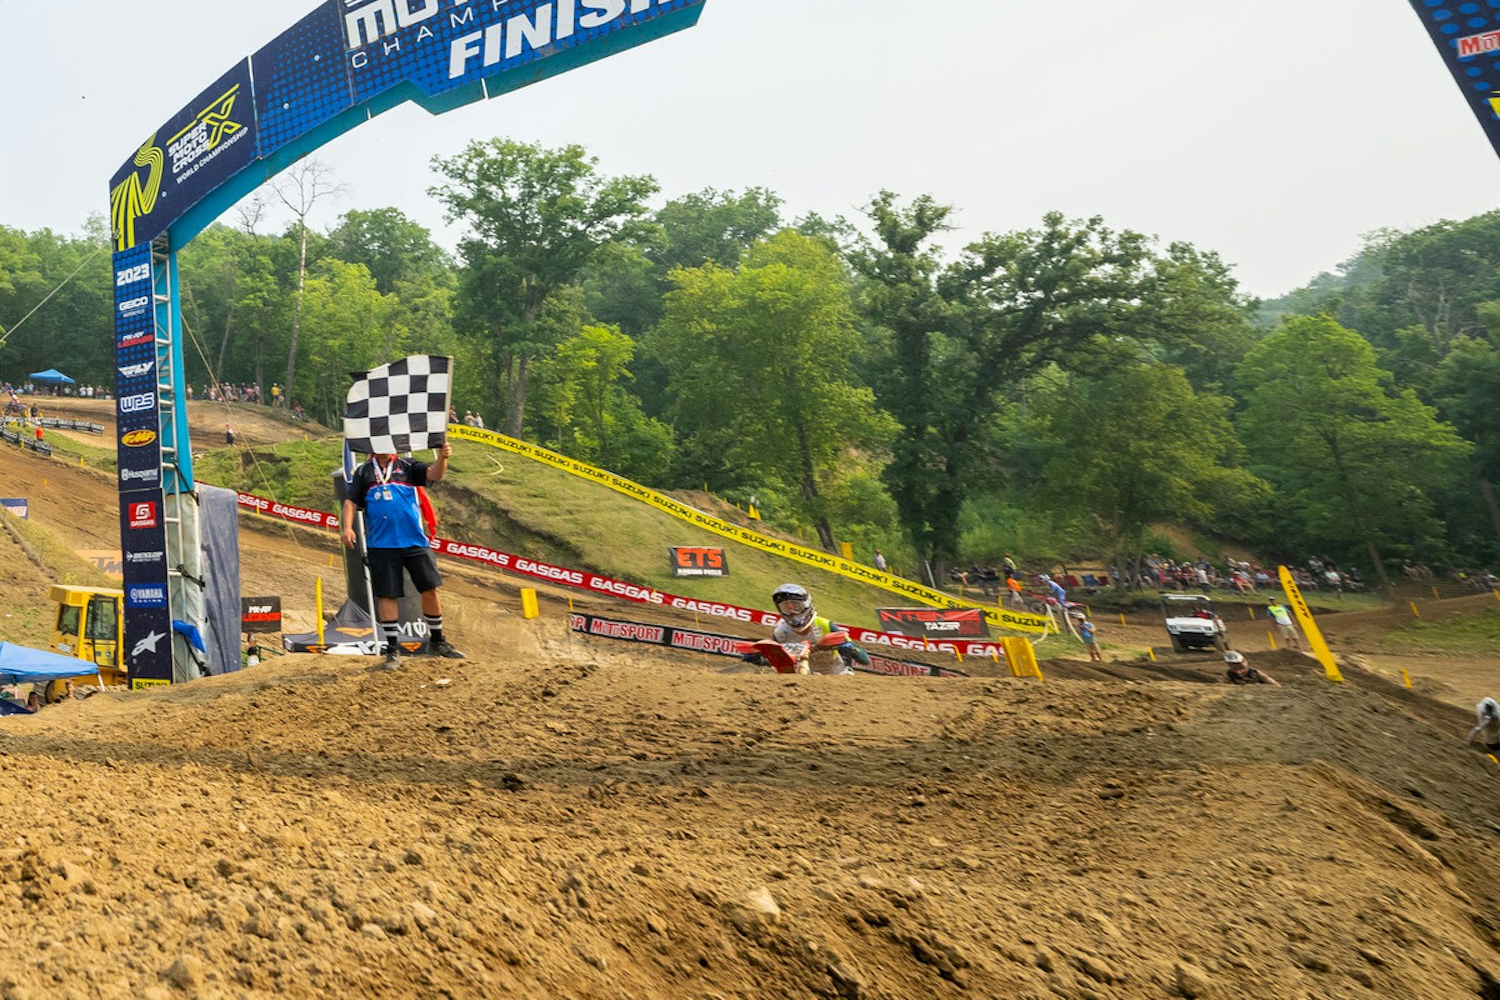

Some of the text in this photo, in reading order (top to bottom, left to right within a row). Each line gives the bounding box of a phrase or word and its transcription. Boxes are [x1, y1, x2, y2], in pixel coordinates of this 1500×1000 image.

[168, 121, 207, 157] SUPER
[173, 131, 208, 163] MOTO
[172, 139, 210, 173] CROSS
[176, 127, 248, 184] WORLD CHAMPIONSHIP
[116, 263, 150, 286] 2023
[119, 296, 148, 311] GEICO
[120, 392, 154, 413] WPS
[459, 428, 494, 441] SUZUKI
[496, 437, 532, 455] SUZUKI
[534, 449, 570, 468] SUZUKI
[572, 463, 609, 482] SUZUKI
[612, 478, 650, 498] SUZUKI
[653, 495, 692, 519] SUZUKI
[695, 514, 738, 535] SUZUKI
[741, 531, 786, 551] SUZUKI
[789, 547, 836, 567] SUZUKI
[840, 562, 888, 583] SUZUKI
[892, 578, 942, 604] SUZUKI
[272, 504, 322, 522] GASGAS
[447, 543, 509, 566] GASGAS
[515, 559, 583, 584] GASGAS
[590, 576, 664, 604] GASGAS
[672, 597, 752, 622] GASGAS
[676, 547, 722, 568] ETS
[138, 588, 164, 599] YAMAHA
